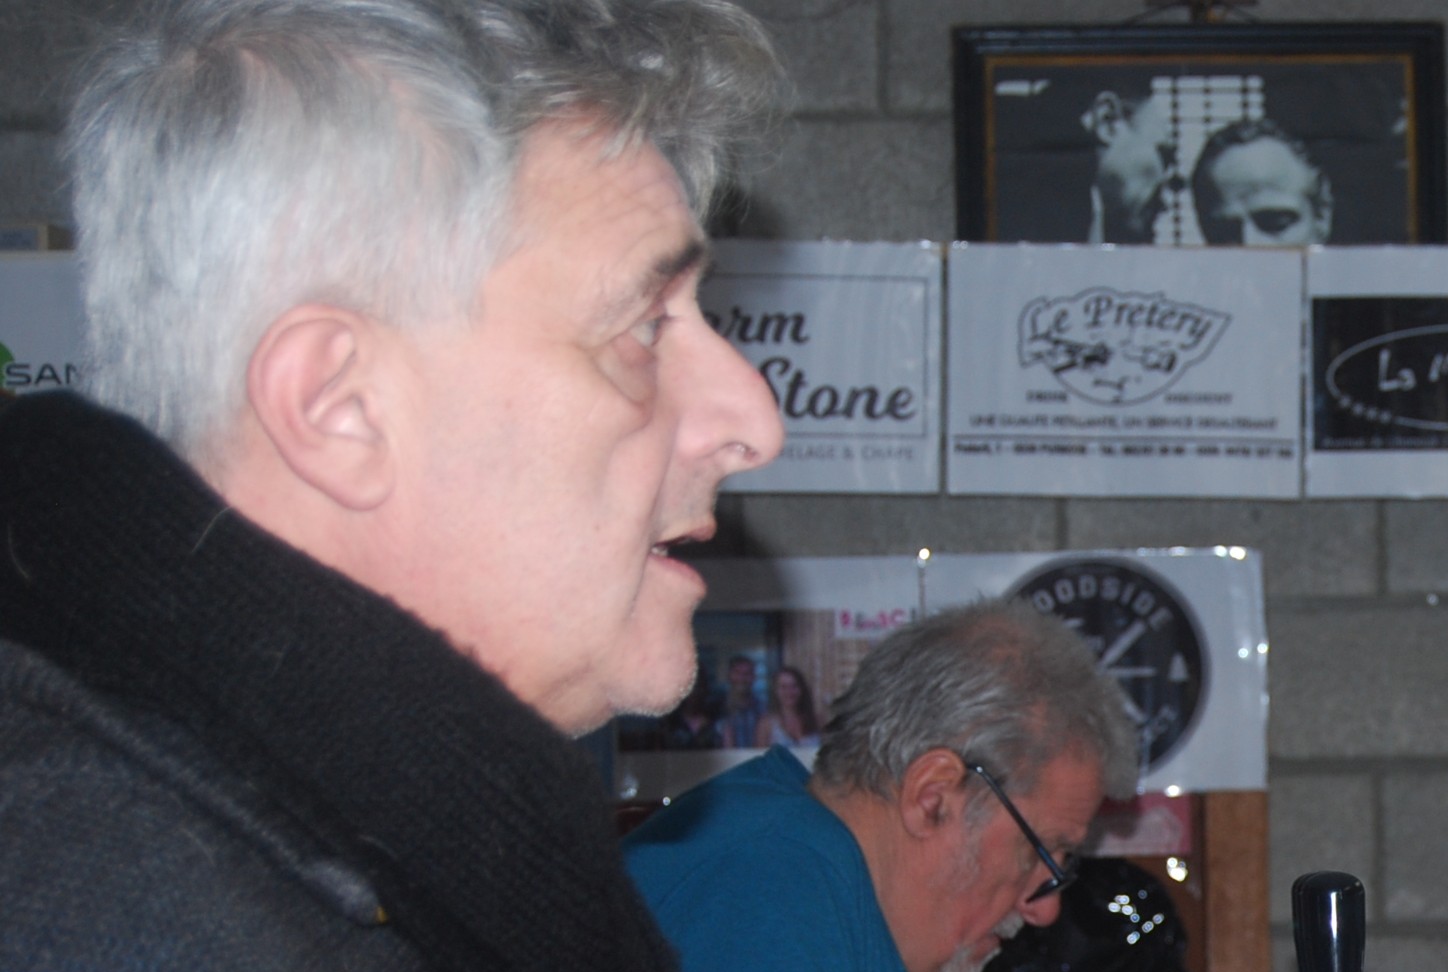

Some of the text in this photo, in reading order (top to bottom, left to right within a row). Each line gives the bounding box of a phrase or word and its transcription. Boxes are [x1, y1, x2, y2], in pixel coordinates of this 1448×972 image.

[758, 356, 917, 422] Stone
[1378, 349, 1417, 391] La
[1032, 574, 1174, 632] OODSIDE
